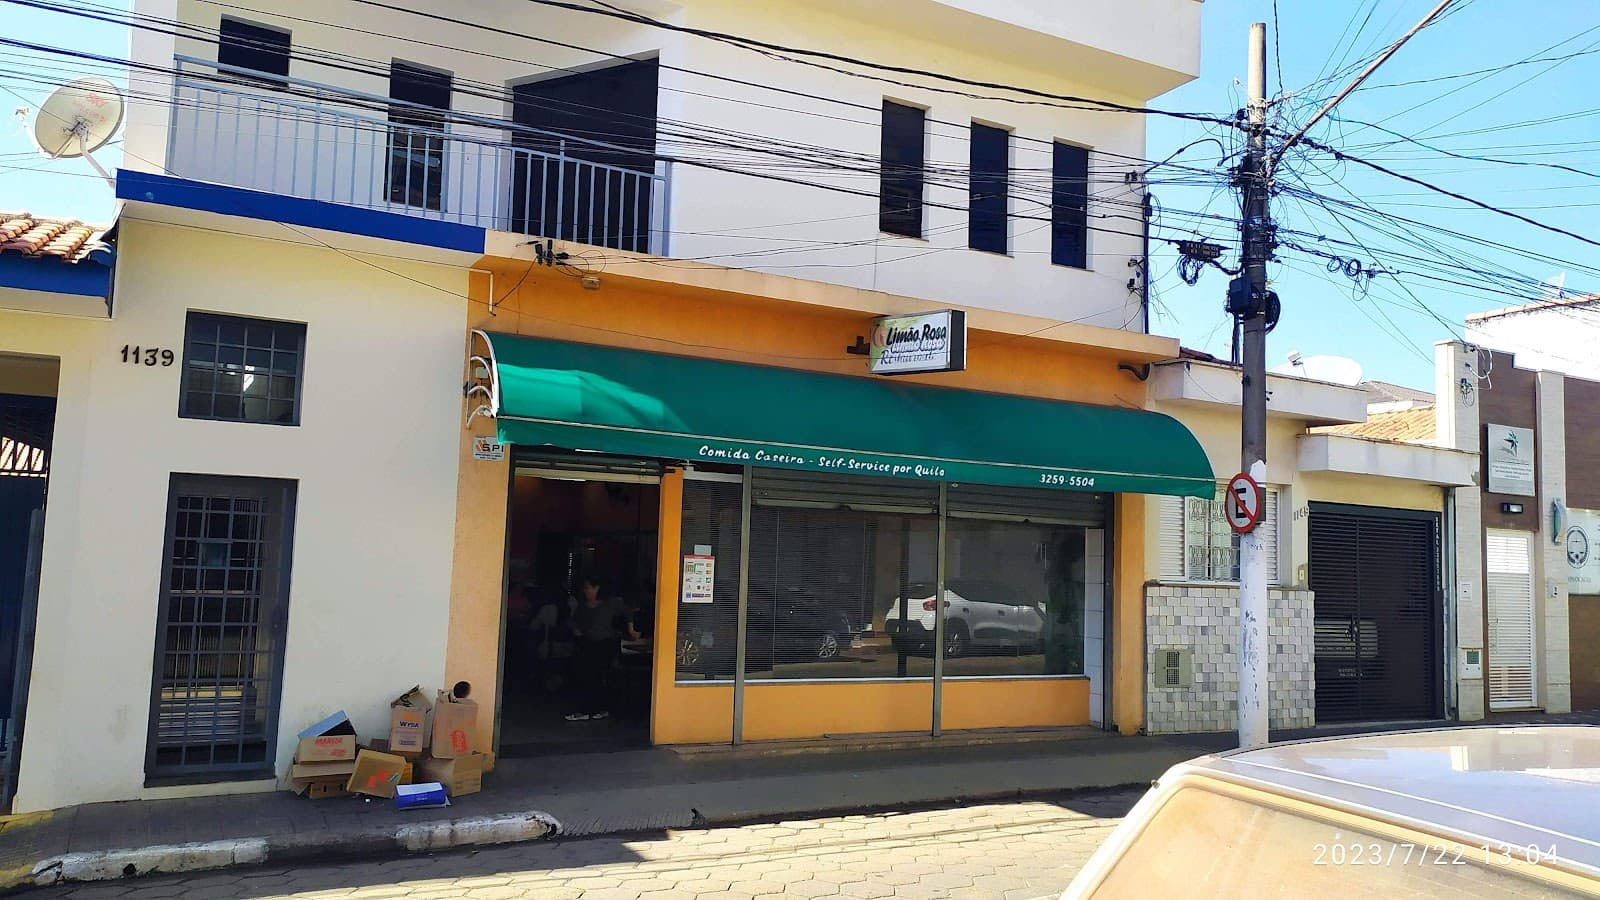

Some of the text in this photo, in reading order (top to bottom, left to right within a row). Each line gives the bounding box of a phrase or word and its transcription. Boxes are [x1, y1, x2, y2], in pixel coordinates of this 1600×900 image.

[886, 323, 946, 345] Limão Rosa
[121, 344, 175, 367] 1139
[482, 443, 504, 453] SPI
[699, 445, 750, 460] Comida
[754, 450, 804, 464] Caseira
[818, 456, 890, 472] Self-Service
[892, 464, 913, 476] por
[914, 464, 945, 477] Quilo
[1039, 473, 1095, 487] 3259-5504
[1234, 487, 1249, 519] E
